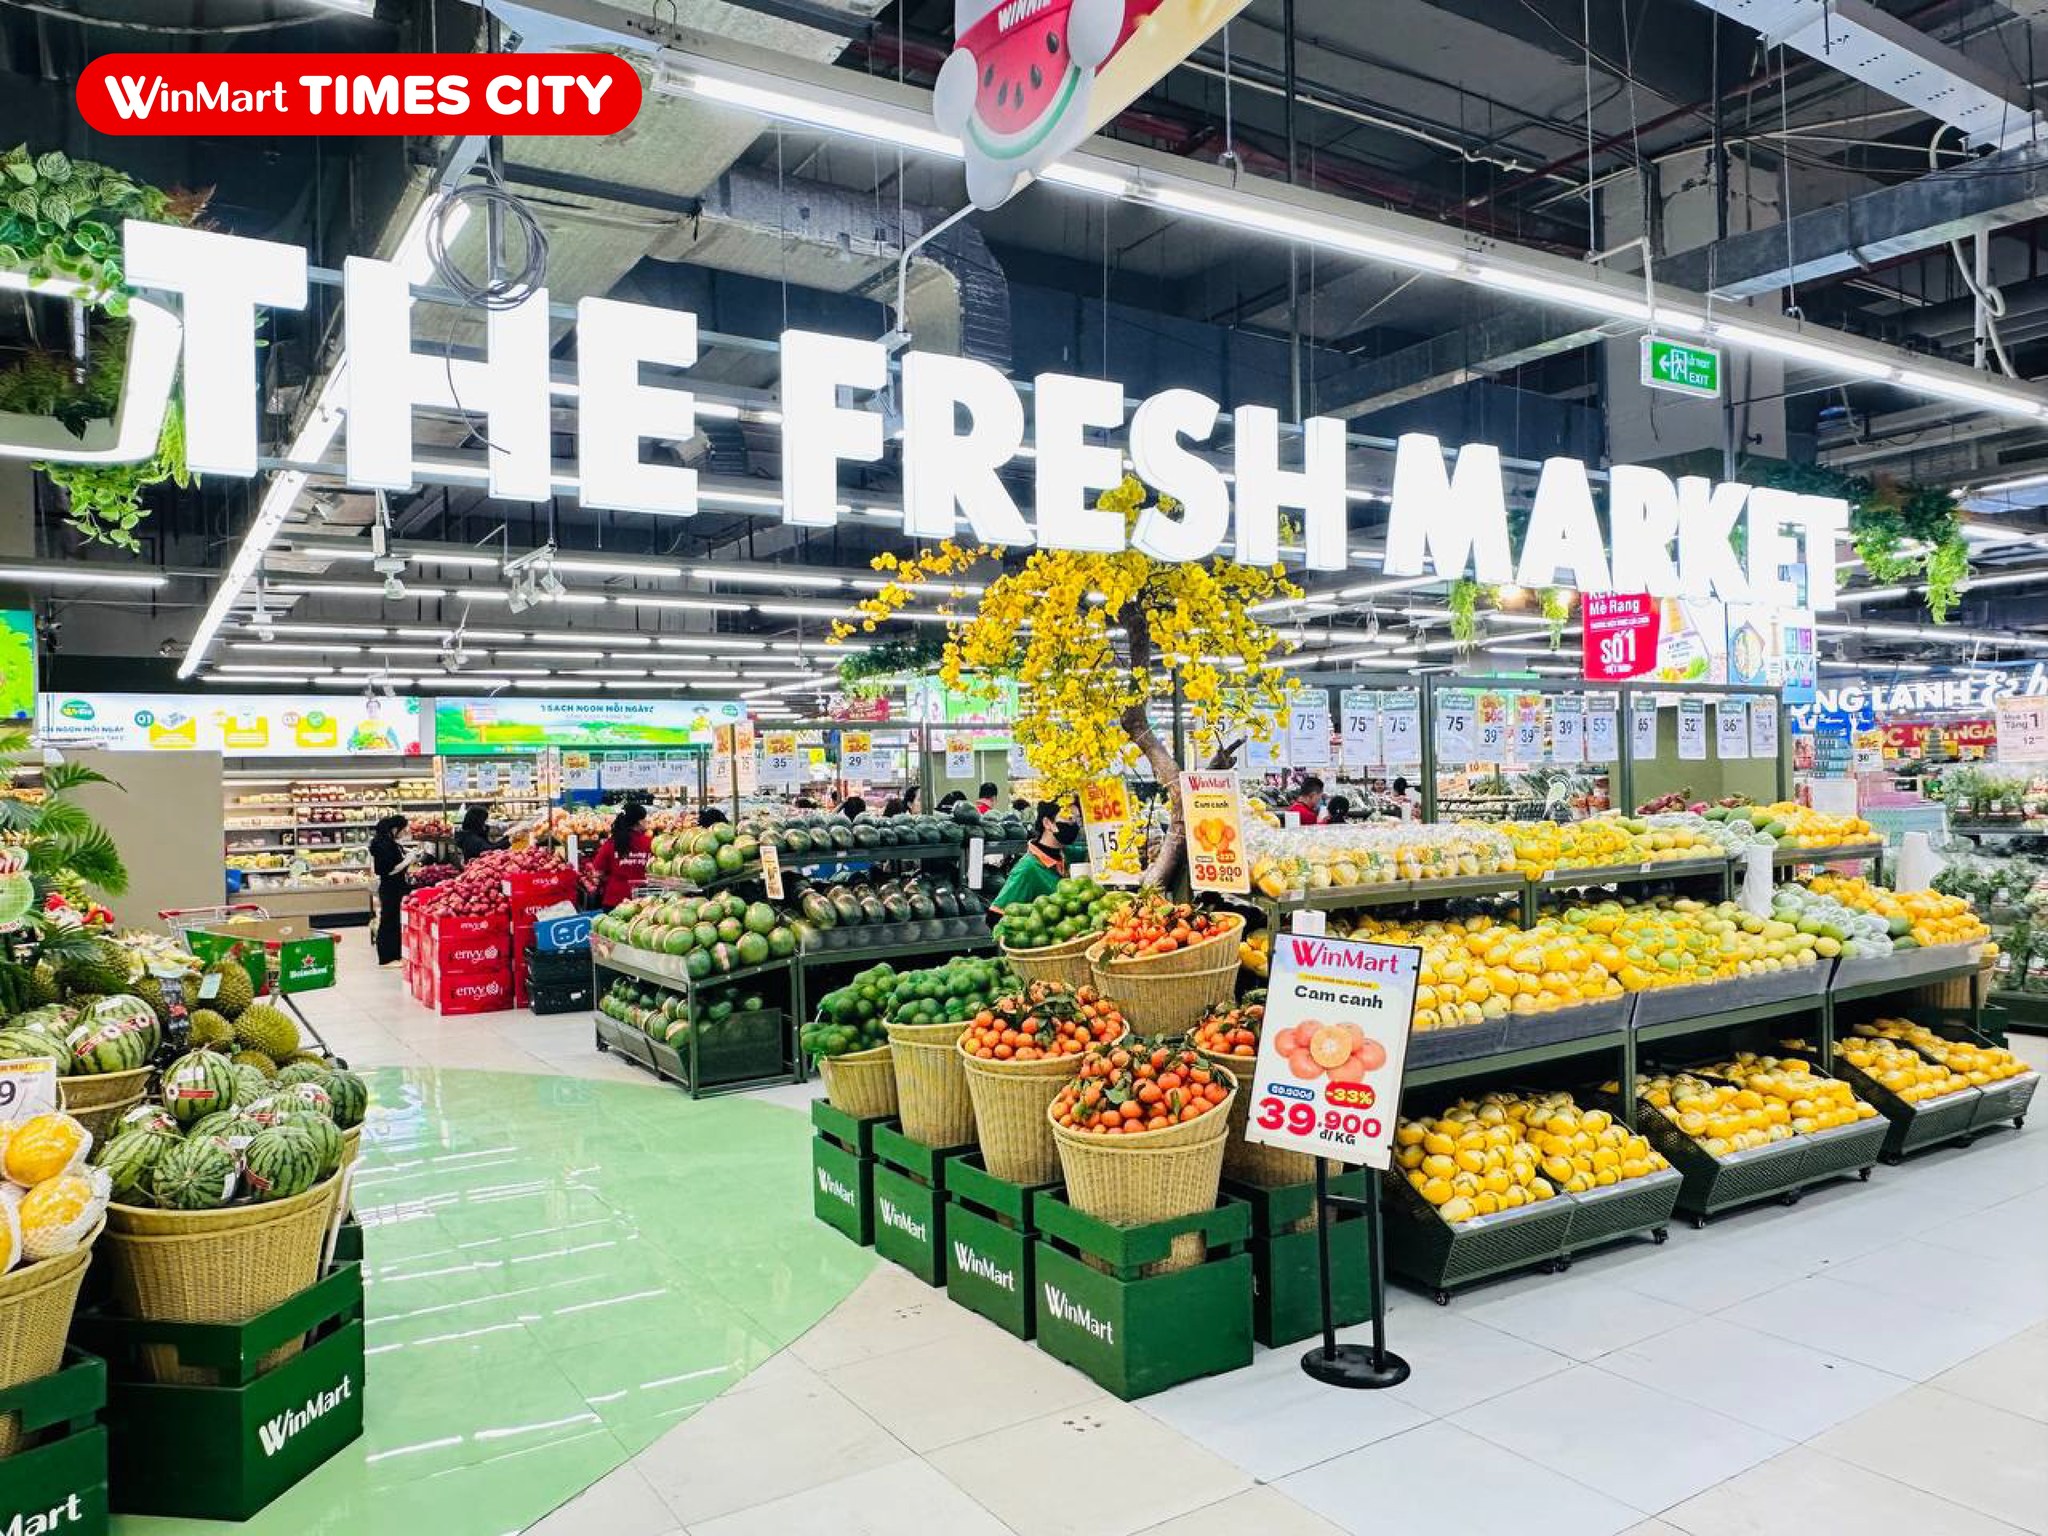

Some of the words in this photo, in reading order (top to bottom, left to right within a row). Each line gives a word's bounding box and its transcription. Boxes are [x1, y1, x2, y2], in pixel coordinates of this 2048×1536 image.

[1690, 373, 1708, 384] EXIT
[123, 218, 699, 517] THE
[780, 329, 1347, 572] FRESH
[1382, 432, 1850, 612] MARKET
[1609, 600, 1639, 614] Rang
[1872, 680, 1971, 713] LẠNH
[1298, 714, 1314, 731] 75
[1349, 716, 1366, 732] 75
[1390, 716, 1407, 732] 75
[1446, 716, 1463, 731] 75
[1559, 719, 1573, 734] 39
[1593, 719, 1607, 732] 55
[2029, 713, 2038, 728] 1
[1484, 729, 1497, 743] 39
[1521, 729, 1534, 743] 39
[773, 758, 787, 768] 35
[849, 756, 862, 767] 29
[1188, 775, 1231, 791] WinMart
[1194, 800, 1210, 808] Cam
[1098, 831, 1118, 853] 15
[455, 949, 485, 964] envy
[1292, 937, 1400, 974] WinMart
[456, 986, 487, 1000] envy
[1294, 984, 1335, 1003] Cam
[1338, 992, 1383, 1009] canh
[1326, 1087, 1373, 1105] -33%
[1256, 1096, 1382, 1138] 39.900
[817, 1165, 855, 1207] WinMart
[879, 1195, 926, 1242] WinMart
[954, 1240, 1015, 1292] WinMart
[1045, 1281, 1115, 1345] WinMart
[258, 1374, 353, 1457] WinMart
